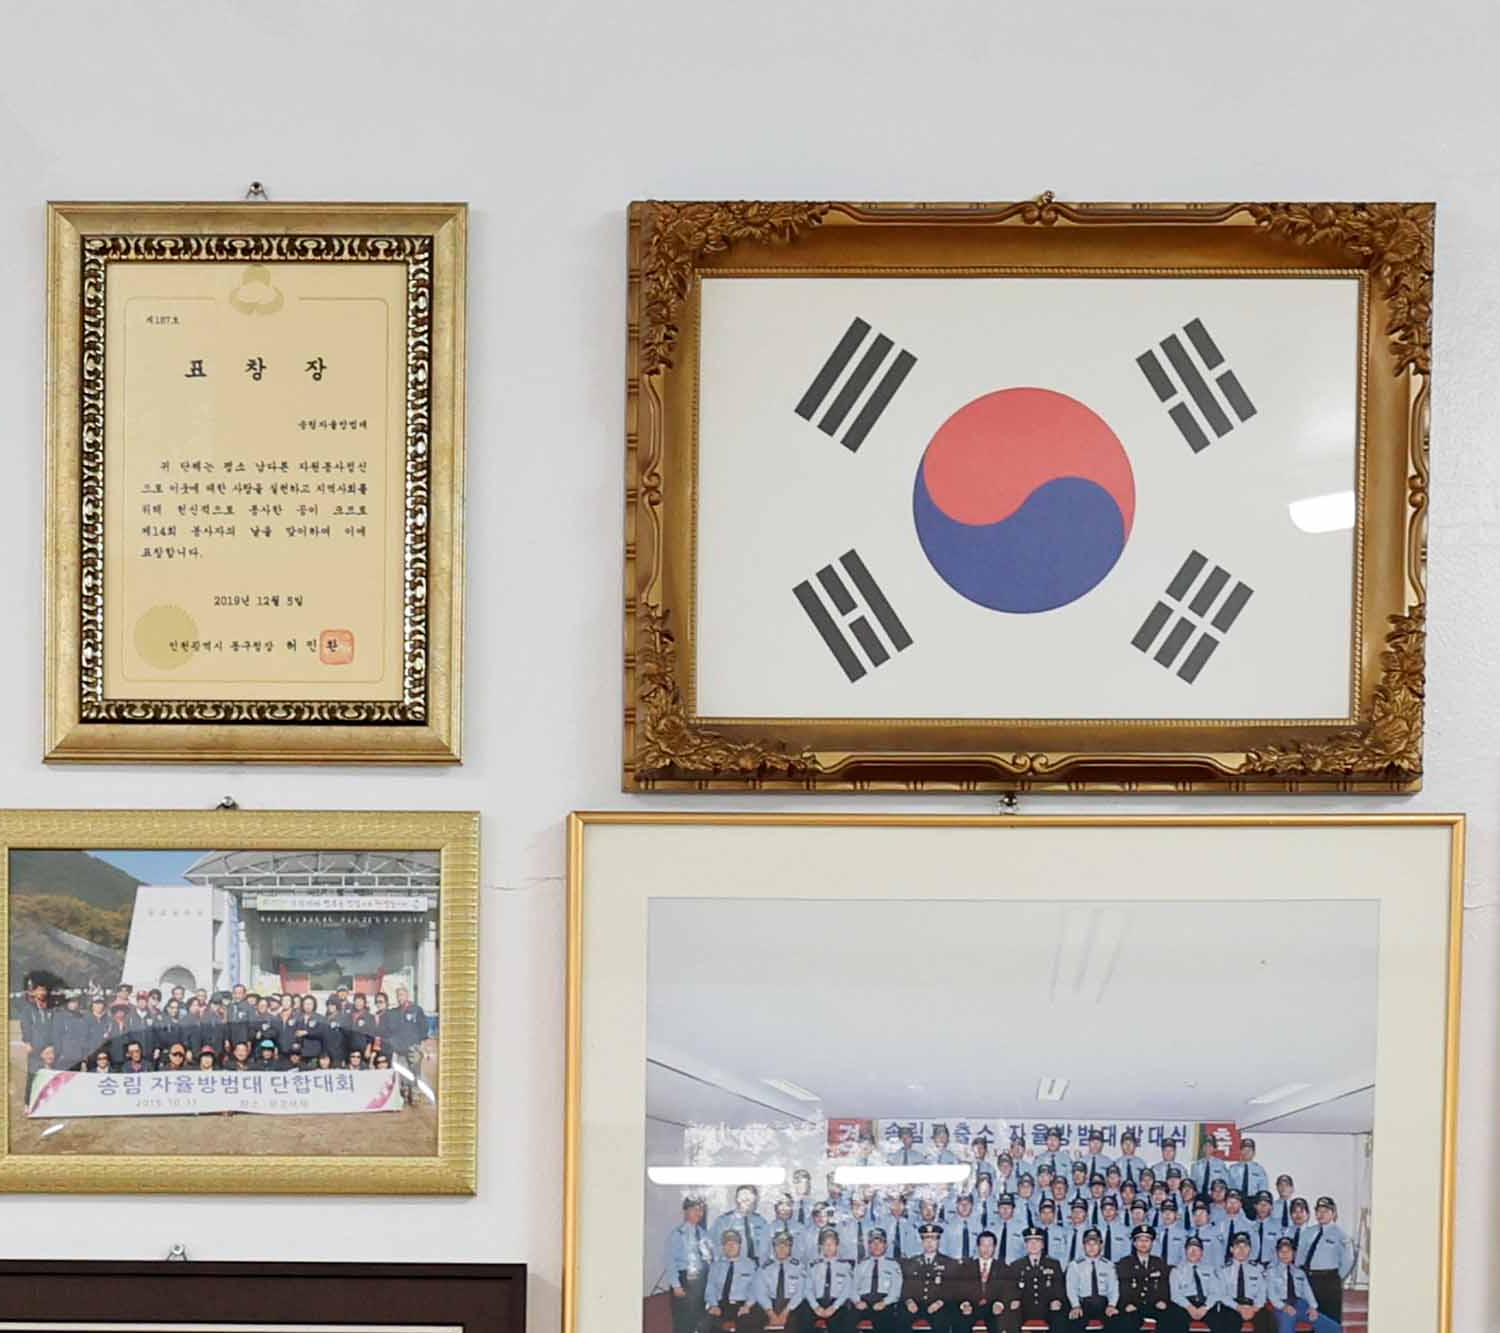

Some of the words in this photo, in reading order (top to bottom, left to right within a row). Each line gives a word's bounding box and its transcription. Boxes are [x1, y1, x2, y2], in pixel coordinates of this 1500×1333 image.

[98, 1076, 142, 1096] 송림
[151, 1075, 263, 1095] 자율방범대
[270, 1073, 355, 1094] 단합대회
